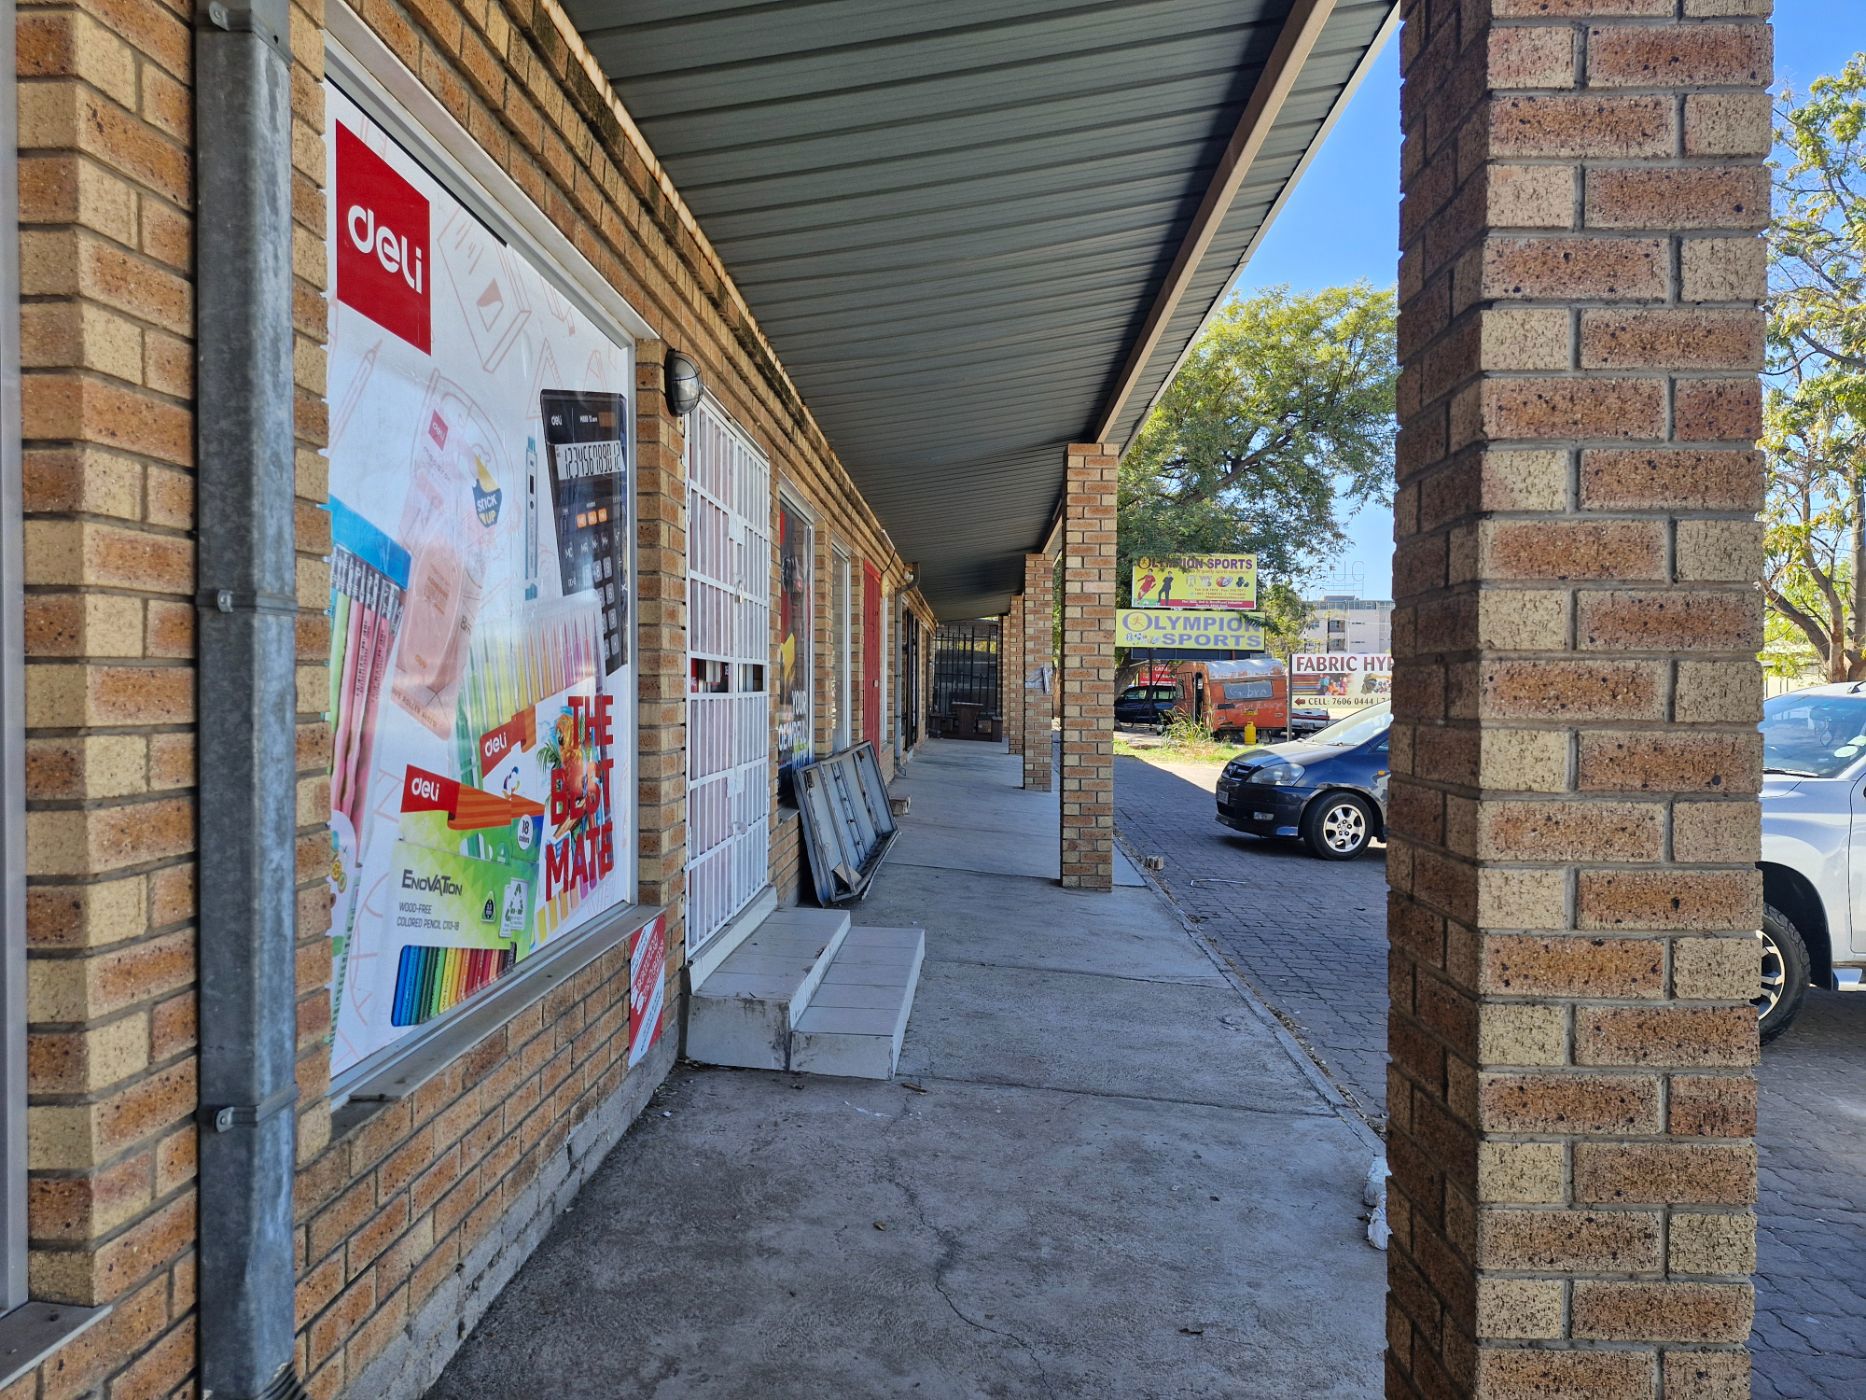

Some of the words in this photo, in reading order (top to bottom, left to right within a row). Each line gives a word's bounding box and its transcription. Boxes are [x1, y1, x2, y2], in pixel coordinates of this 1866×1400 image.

[347, 204, 422, 295] deli
[1207, 558, 1253, 570] SPORTS
[1122, 611, 1261, 633] OLYMPION
[1161, 633, 1262, 648] SPORTS
[1296, 656, 1358, 672] FABRIC
[1332, 697, 1352, 706] 7606
[1354, 697, 1374, 706] 0444
[568, 695, 614, 750] THE
[484, 731, 507, 757] deli
[411, 777, 440, 802] deli
[551, 758, 614, 827] BEST
[545, 821, 614, 903] MATE
[399, 901, 433, 915] WOOD-FREE
[396, 916, 423, 928] COLORED
[423, 919, 442, 930] PENCIL
